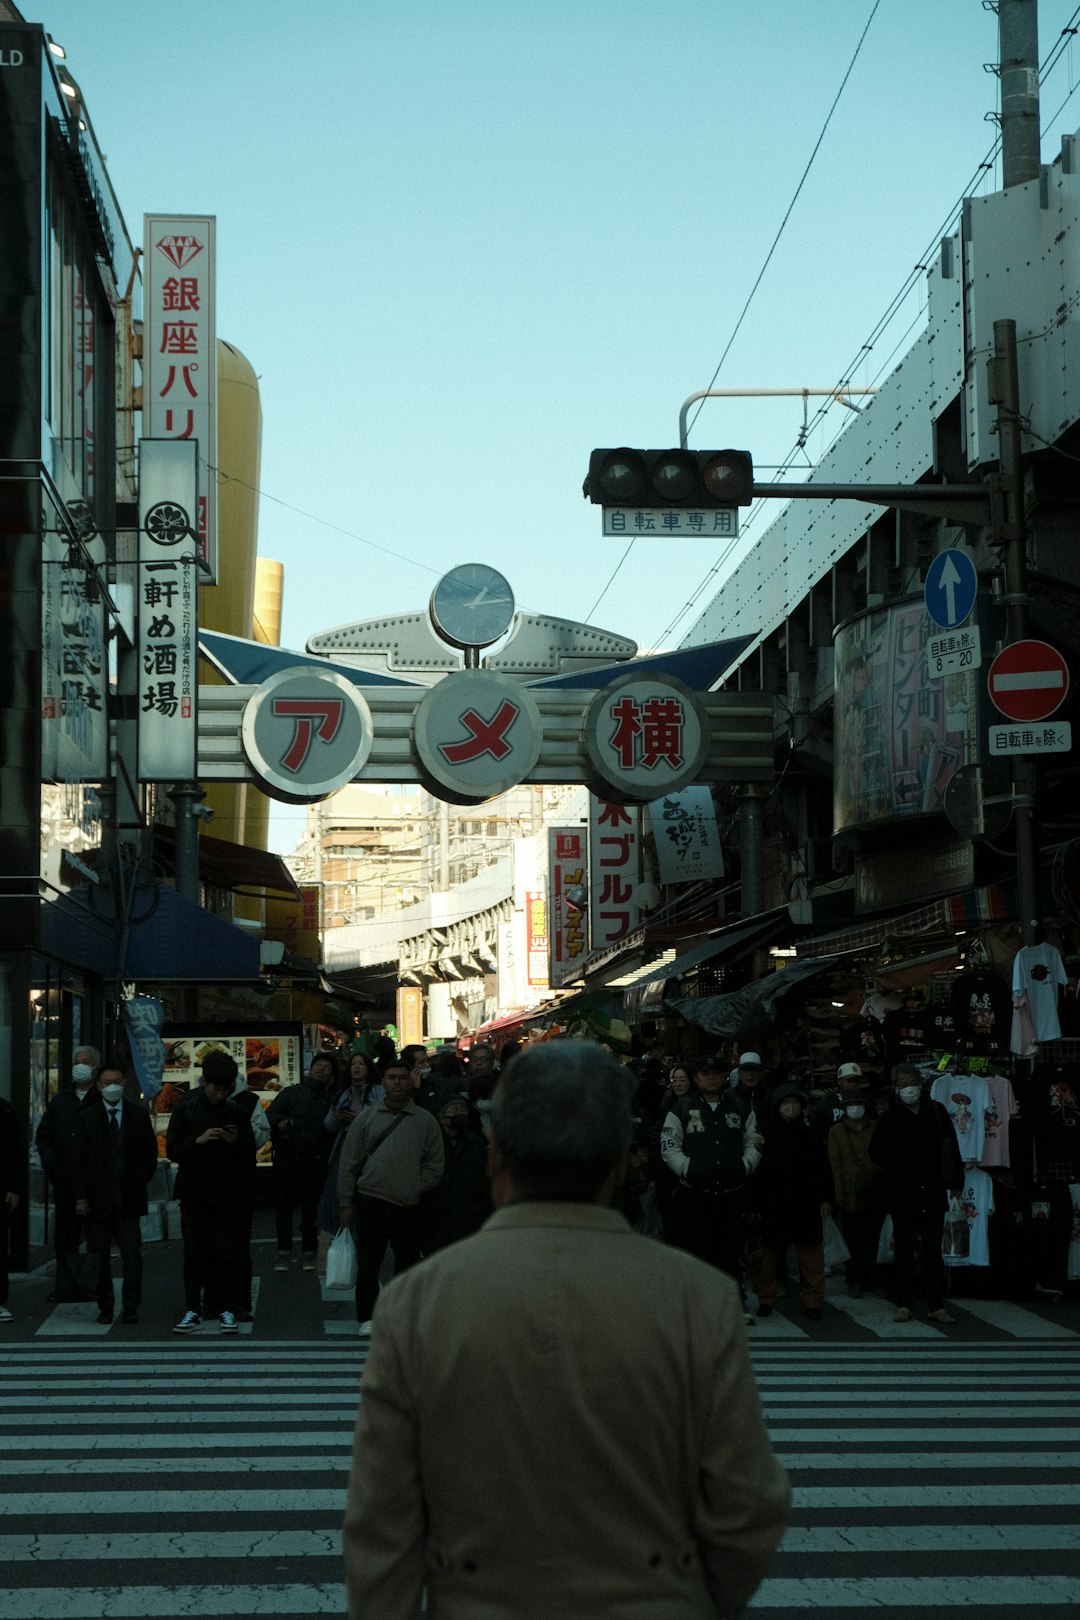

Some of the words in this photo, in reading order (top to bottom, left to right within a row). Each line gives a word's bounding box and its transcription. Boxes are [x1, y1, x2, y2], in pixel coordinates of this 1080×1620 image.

[611, 511, 732, 532] 自転車専用
[142, 563, 179, 718] 一軒め酒場
[931, 634, 976, 656] 自転車を除く
[936, 658, 943, 672] 8
[959, 650, 973, 667] 20
[272, 696, 684, 774] アメ横
[995, 729, 1065, 750] 自転車を除く
[934, 1015, 954, 1026] 日本
[661, 1139, 675, 1153] 25
